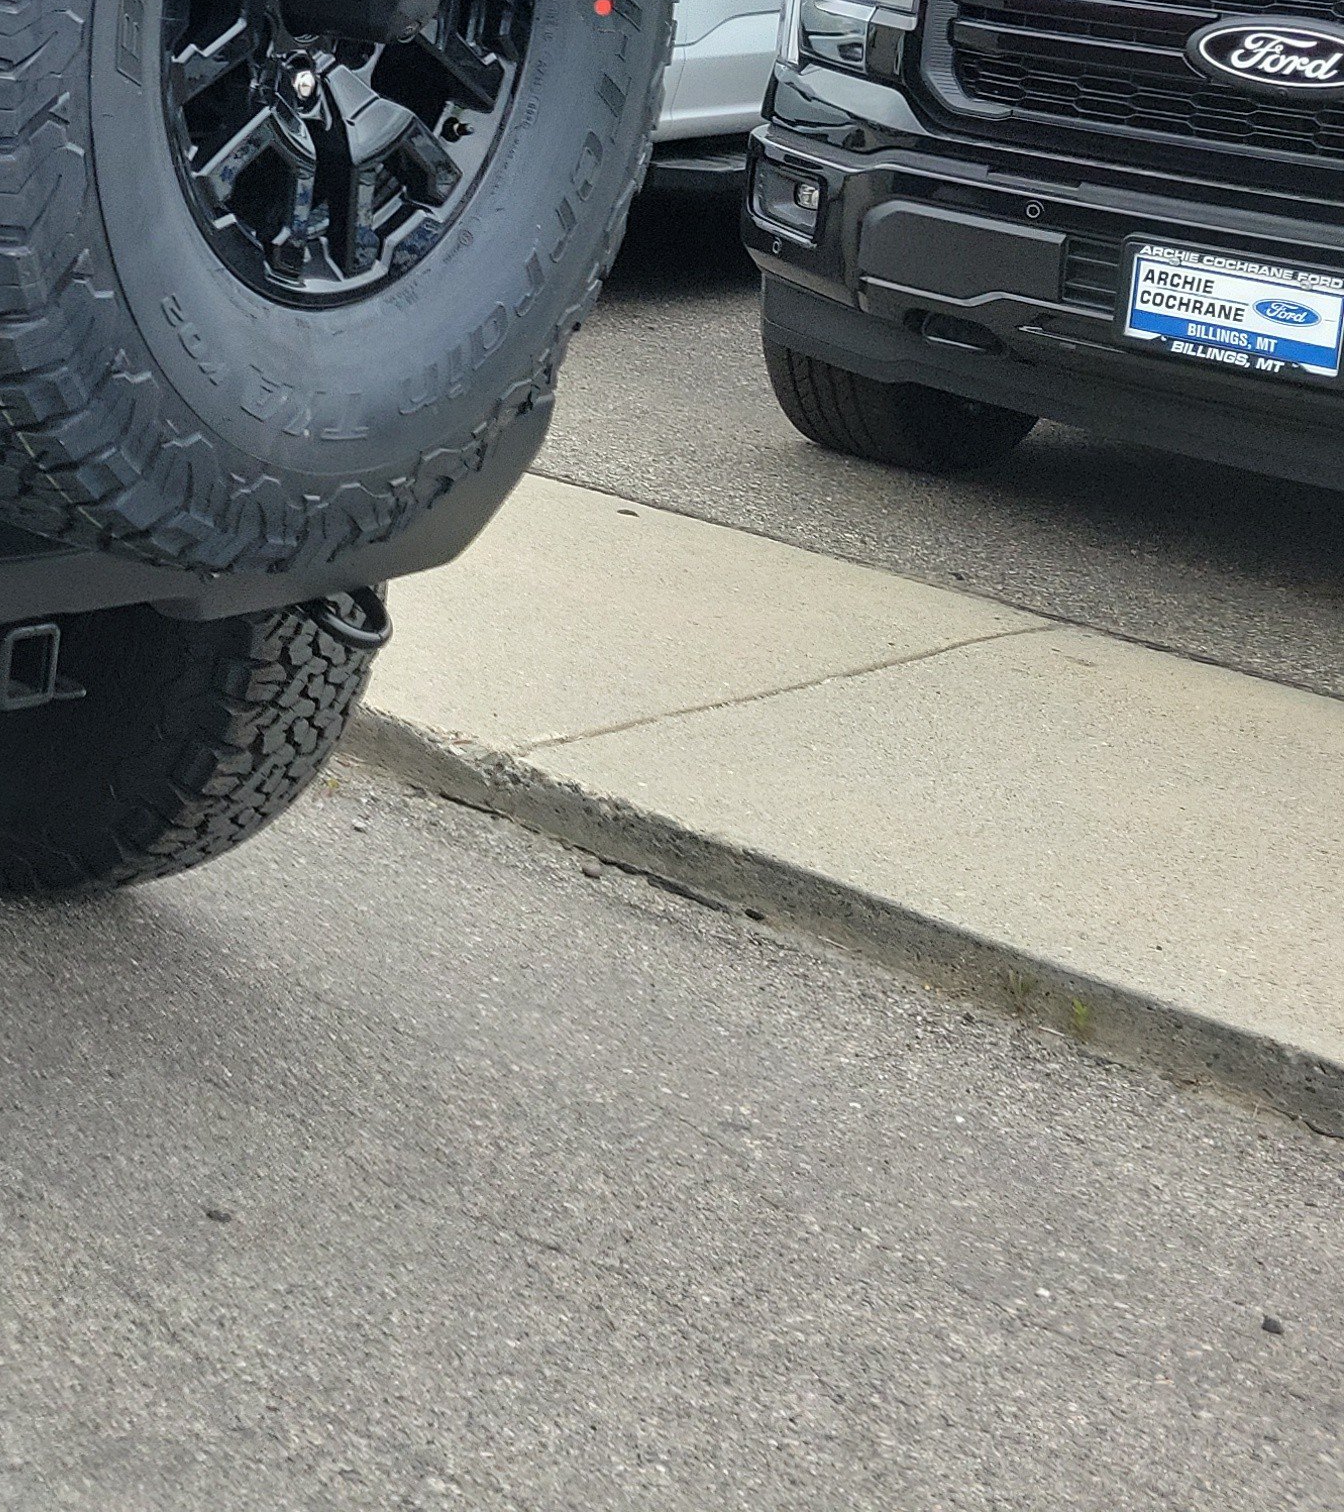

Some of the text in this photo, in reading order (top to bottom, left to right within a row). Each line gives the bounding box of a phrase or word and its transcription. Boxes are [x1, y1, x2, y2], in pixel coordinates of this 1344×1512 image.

[1230, 31, 1343, 81] Ford
[1140, 245, 1343, 289] ARCHIE COCHRANE FORD
[1143, 269, 1215, 294] ARCHIE
[1140, 290, 1245, 322] COCHRANE
[1266, 303, 1306, 323] Ford
[1187, 323, 1277, 353] BILLINGS, MT
[1171, 341, 1285, 373] BILLINGS, MT
